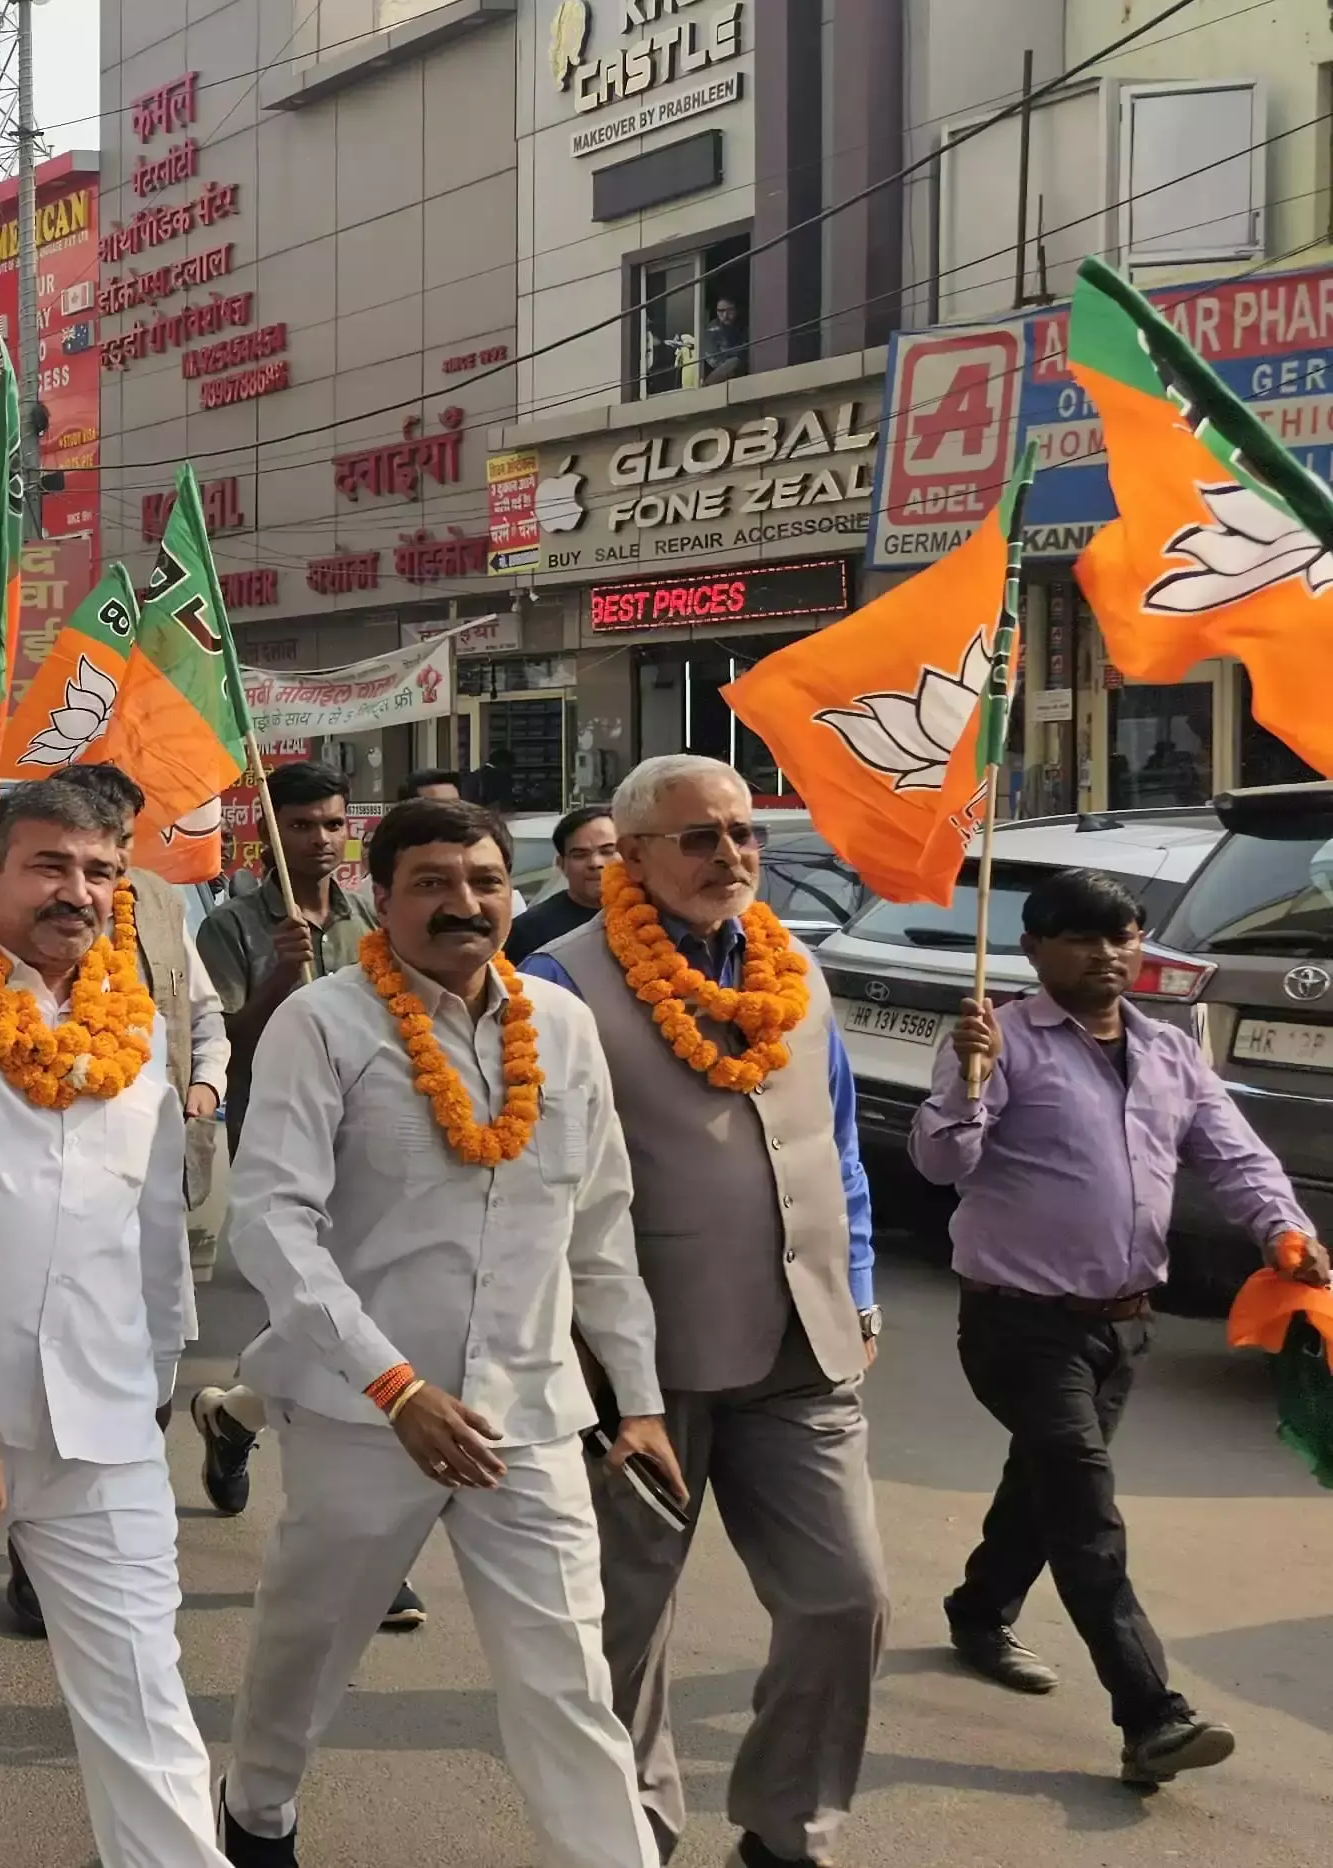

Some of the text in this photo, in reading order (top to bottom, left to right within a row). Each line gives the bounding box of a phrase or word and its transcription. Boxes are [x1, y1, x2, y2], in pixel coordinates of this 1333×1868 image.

[574, 3, 743, 114] CASTLE
[131, 71, 200, 144] कमल
[573, 79, 734, 153] MAKEOVER BY PRABHLEEN
[609, 402, 878, 487] GLOBAL
[608, 463, 874, 534] FONE ZEAL
[903, 483, 984, 516] ADEL
[548, 513, 870, 569] BUY SALE REPAIR ACCESSORIE
[592, 580, 746, 625] BEST PRICES
[854, 1007, 872, 1027] HR
[900, 1014, 936, 1038] 5588
